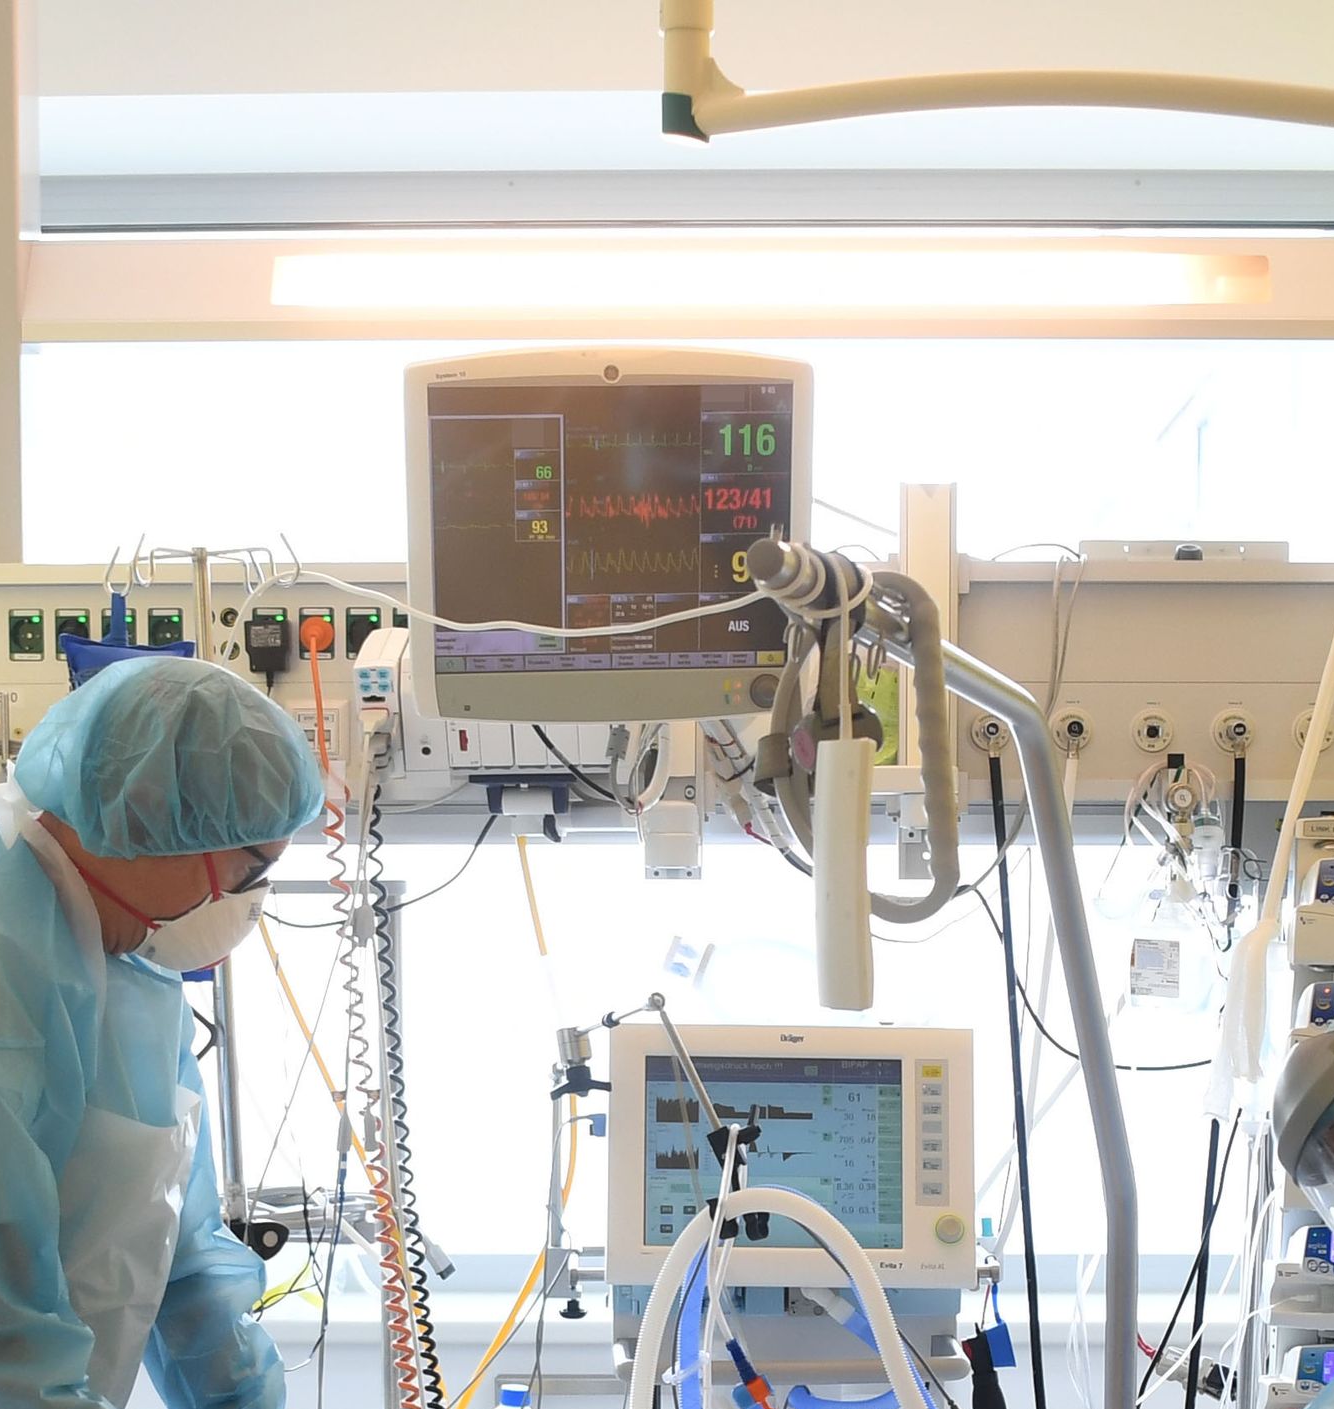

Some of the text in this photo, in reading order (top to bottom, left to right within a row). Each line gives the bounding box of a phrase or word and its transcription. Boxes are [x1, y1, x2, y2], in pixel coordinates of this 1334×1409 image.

[719, 423, 776, 456] 116
[535, 466, 552, 479] 66
[704, 487, 773, 510] 123/41
[531, 520, 548, 534] 93
[733, 515, 758, 529] (71)
[732, 551, 749, 583] 9
[728, 620, 750, 632] AUS
[780, 1034, 804, 1043] Dräger
[848, 1092, 861, 1103] 61
[879, 1261, 897, 1269] Evita
